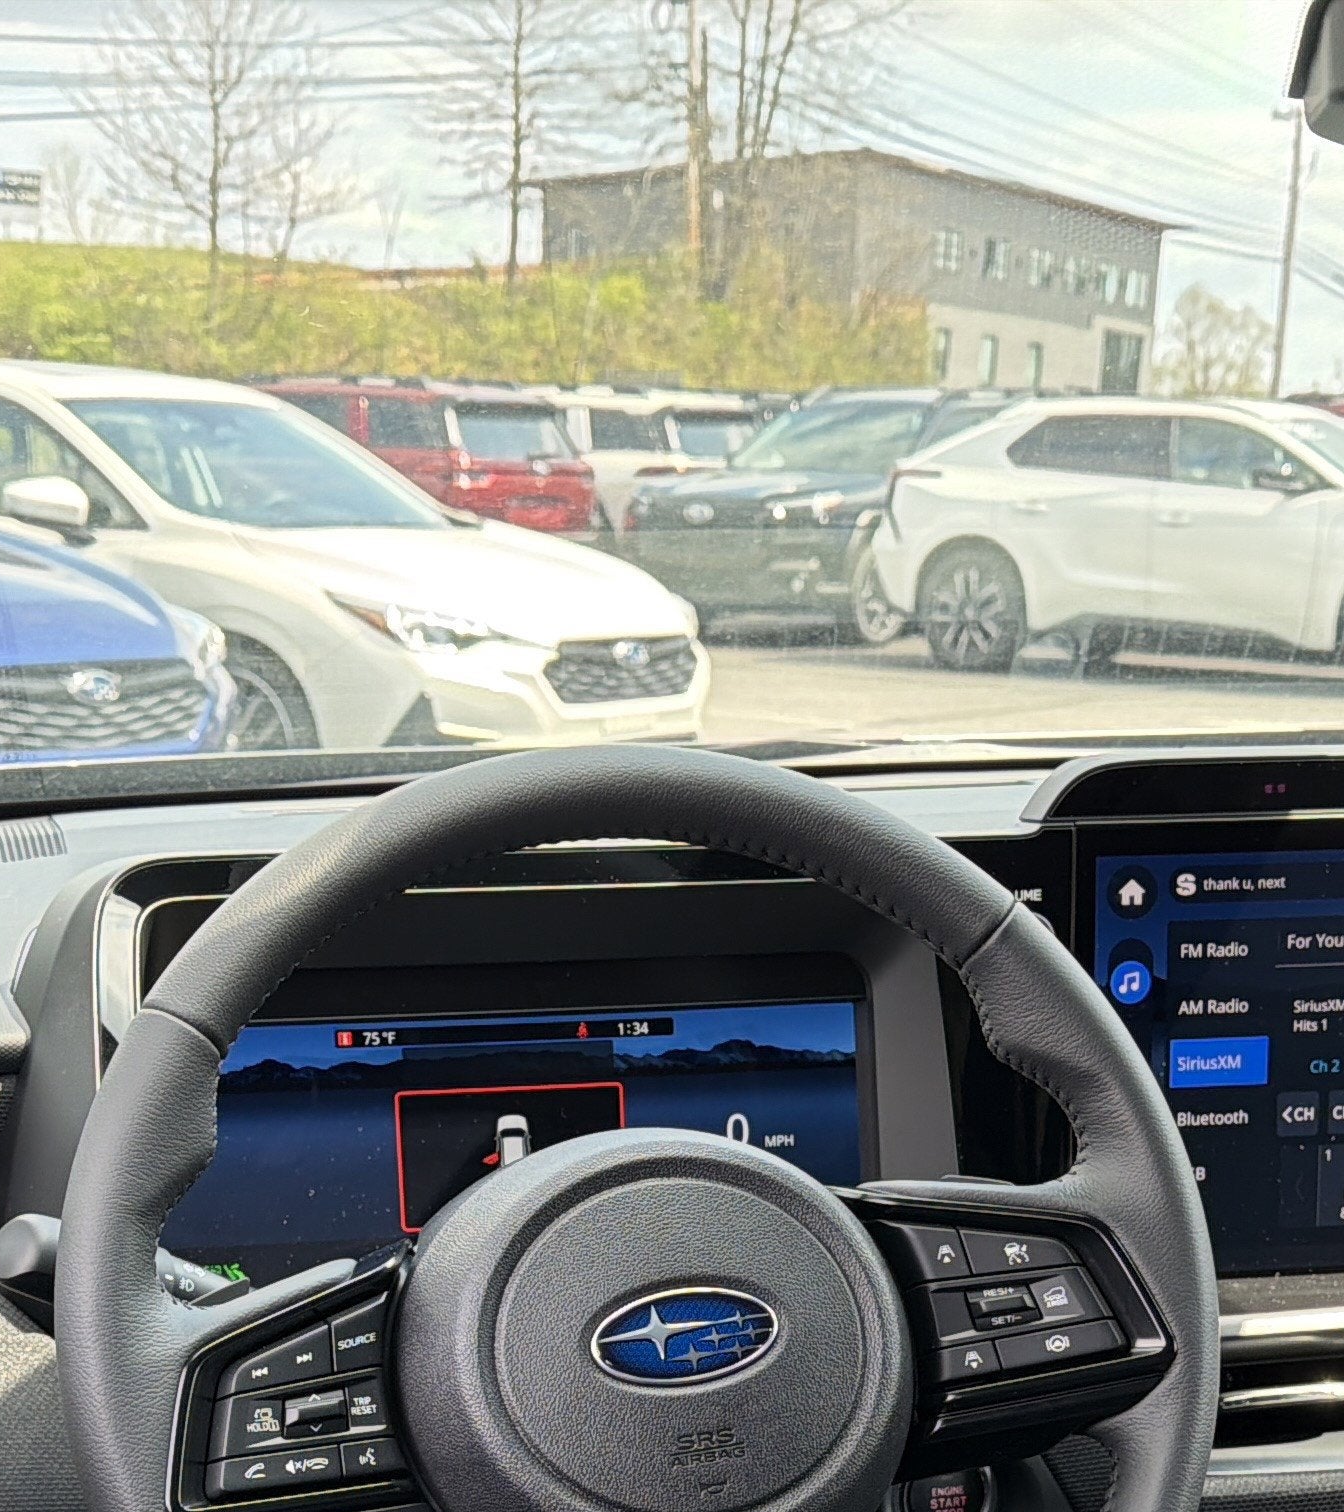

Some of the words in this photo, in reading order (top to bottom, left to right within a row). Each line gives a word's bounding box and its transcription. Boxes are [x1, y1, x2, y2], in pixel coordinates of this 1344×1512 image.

[1203, 876, 1241, 892] thank
[1242, 879, 1255, 893] u,
[1257, 876, 1286, 891] next
[1013, 888, 1043, 902] UME
[1287, 934, 1312, 950] For
[1315, 932, 1344, 949] You
[1180, 943, 1203, 959] FM
[1207, 941, 1249, 958] Radio
[1177, 1001, 1203, 1016] AM
[1207, 998, 1249, 1015] Radio
[617, 1021, 649, 1036] 1:34
[1292, 1017, 1319, 1033] Hits
[1320, 1017, 1329, 1032] 1
[1177, 1053, 1242, 1072] SiriusXM
[1309, 1059, 1328, 1074] Ch
[1330, 1059, 1341, 1073] 2
[1177, 1109, 1249, 1127] Bluetooth
[764, 1133, 795, 1148] MPH
[1324, 1149, 1332, 1162] 1
[337, 1331, 377, 1351] SOURCE
[352, 1396, 372, 1406] TRIP
[350, 1404, 377, 1416] RESET
[676, 1428, 736, 1451] SRS
[671, 1448, 747, 1469] AIRBAG
[931, 1486, 966, 1498] ENGINE
[929, 1496, 968, 1509] START
